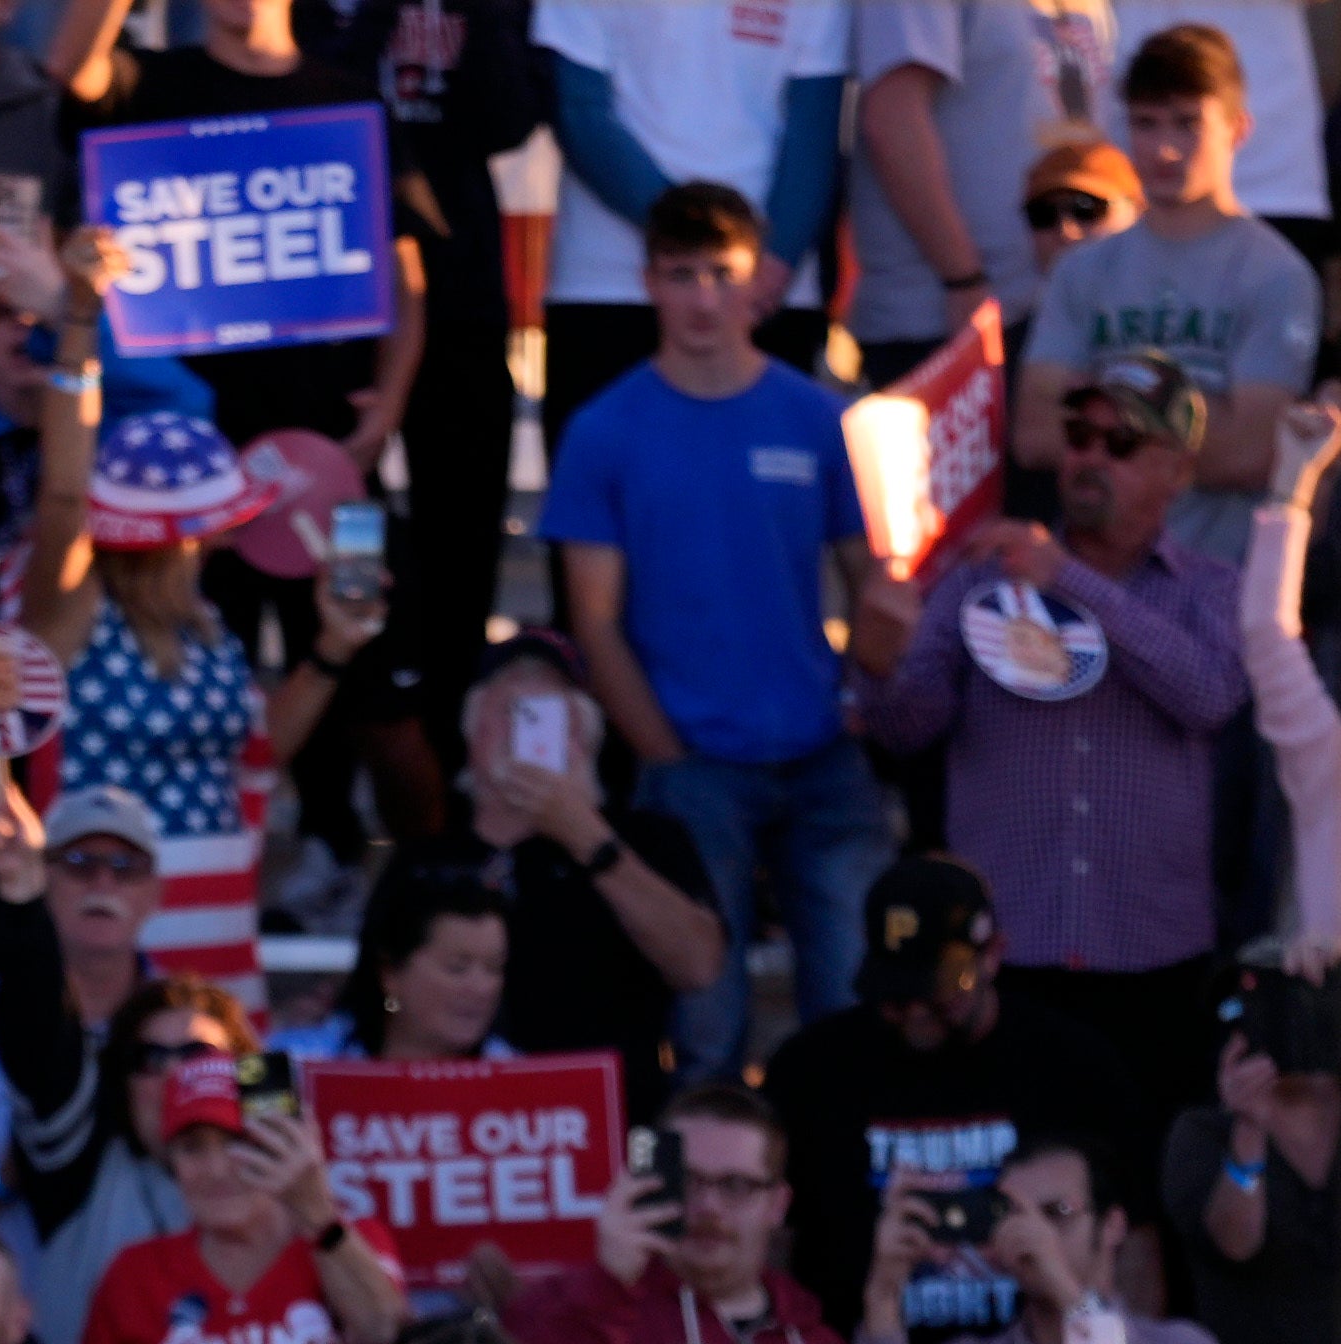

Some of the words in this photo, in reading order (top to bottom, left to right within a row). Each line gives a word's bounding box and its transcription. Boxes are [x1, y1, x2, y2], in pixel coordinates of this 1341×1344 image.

[114, 170, 240, 224] SAVE
[245, 161, 357, 212] OUR
[115, 206, 373, 295] STEEL
[329, 1111, 461, 1161] SAVE
[471, 1106, 589, 1155] OUR
[327, 1152, 609, 1229] STEEL
